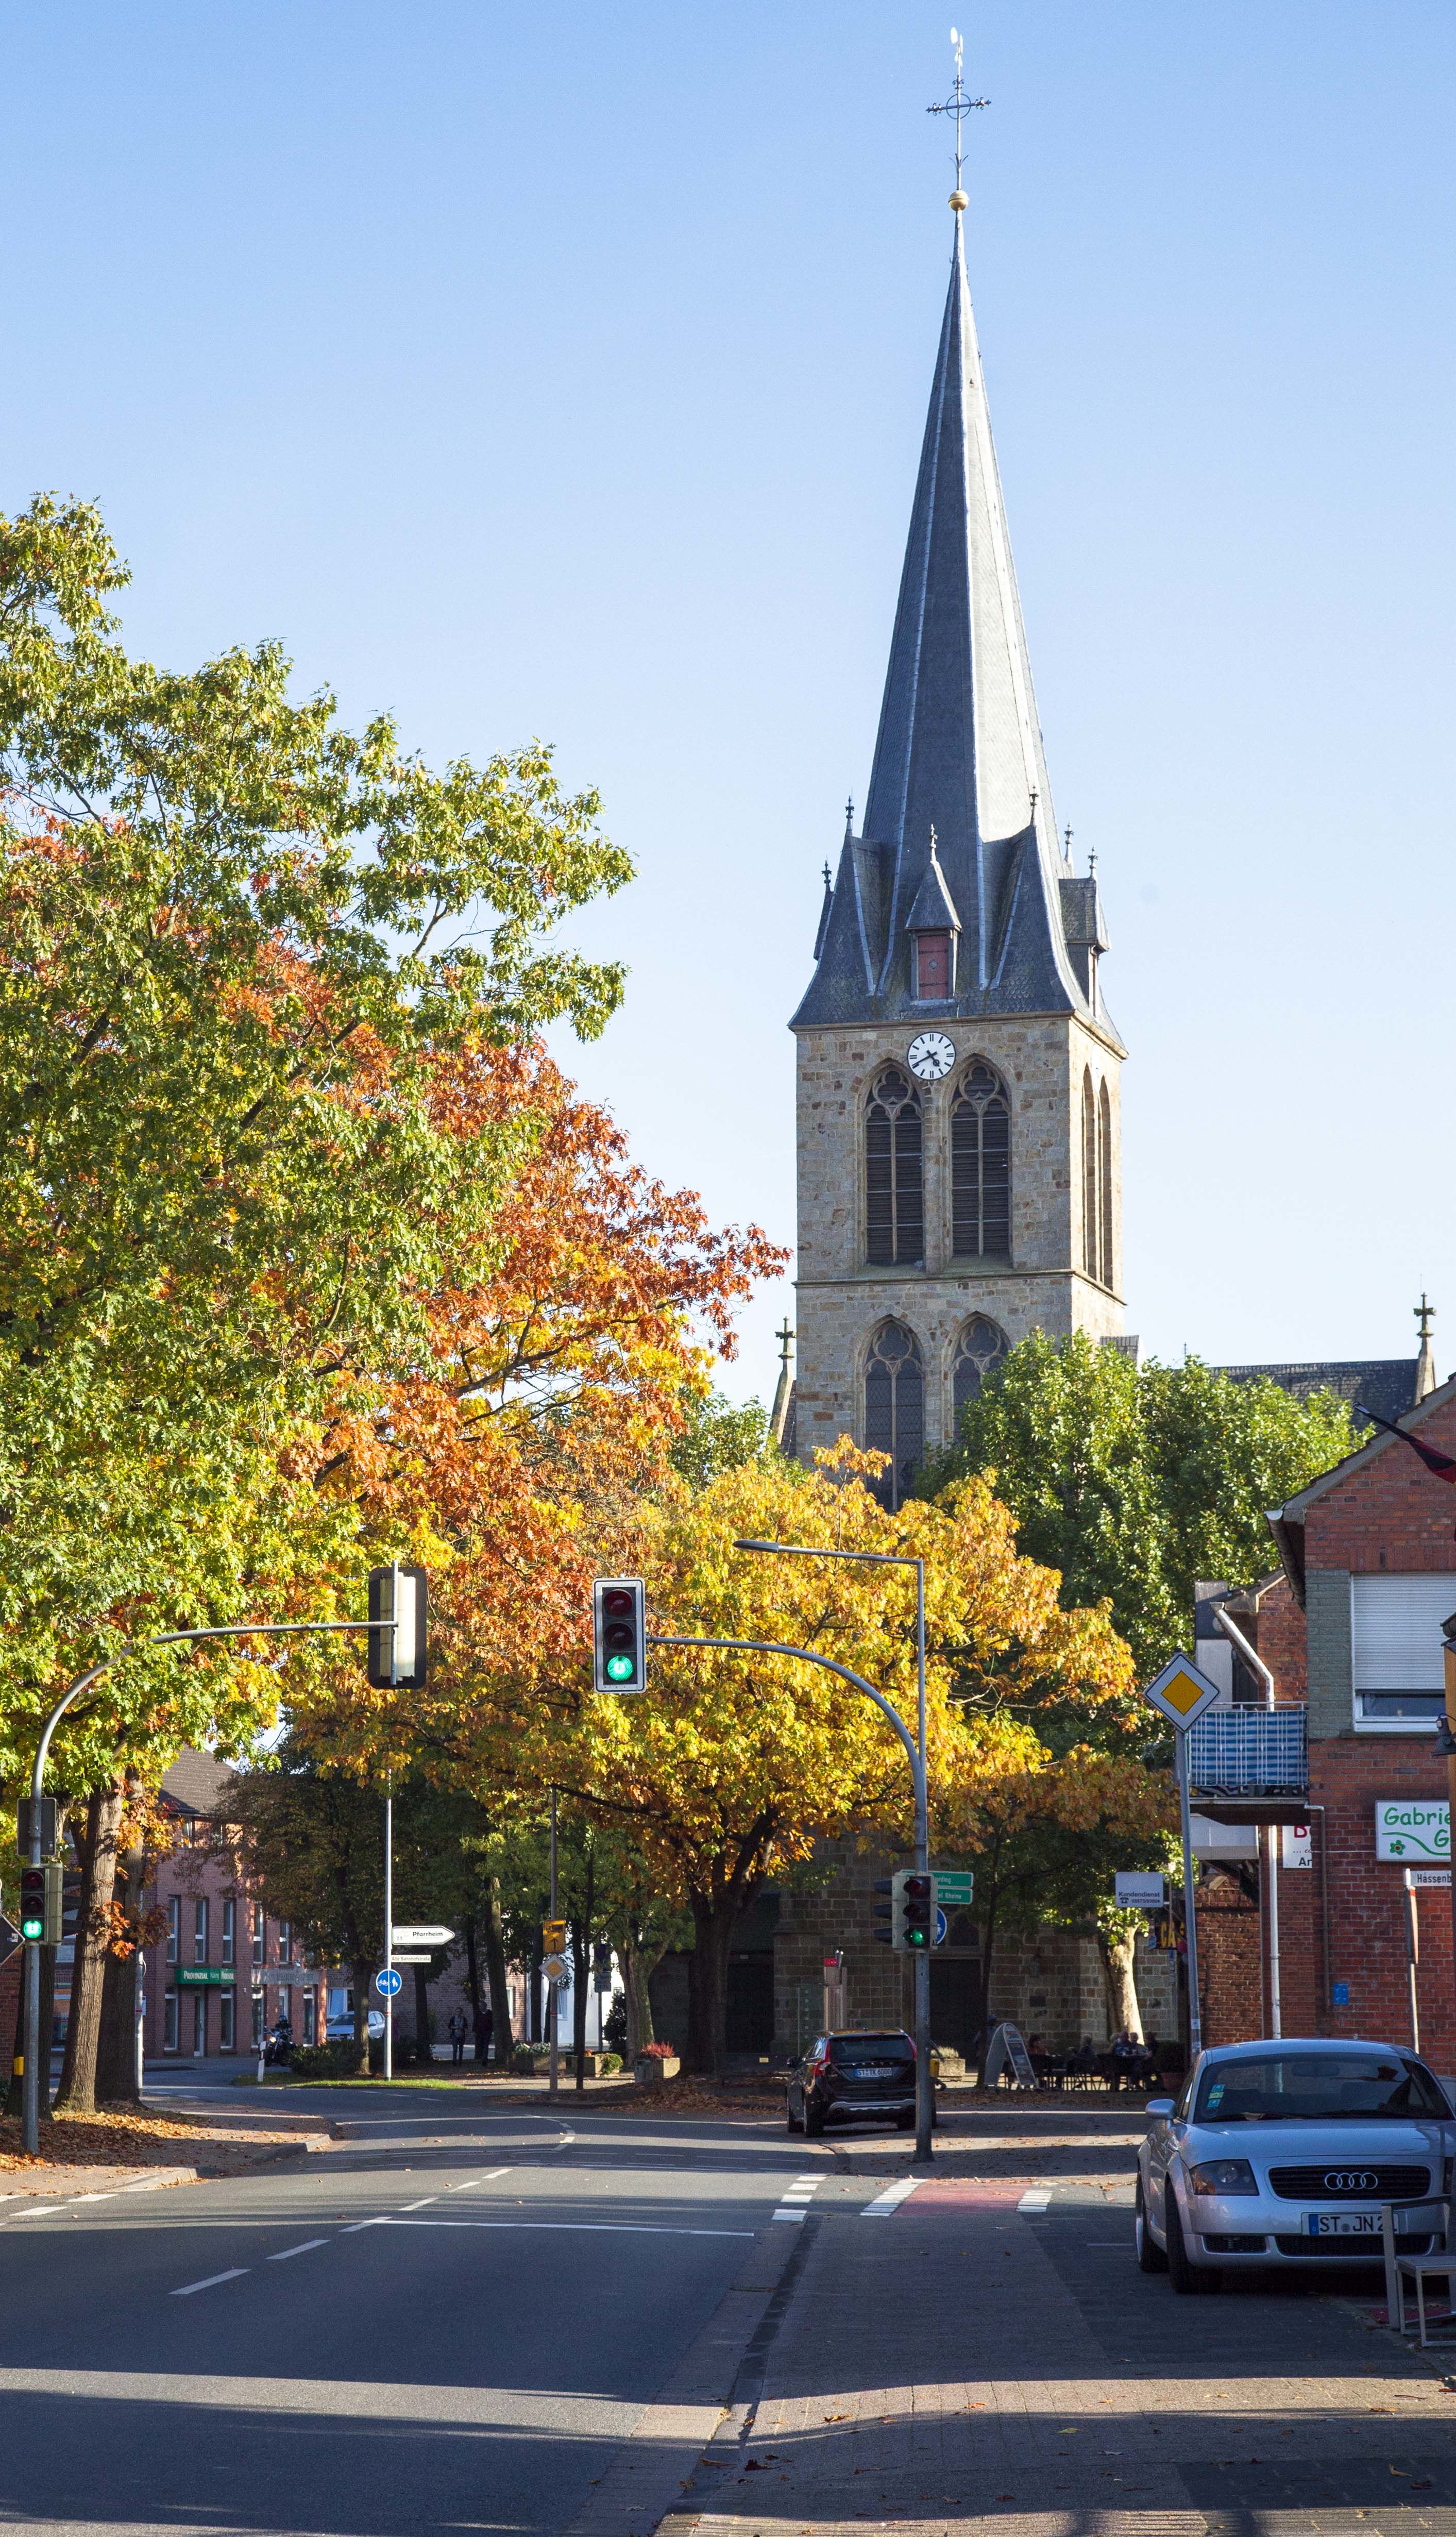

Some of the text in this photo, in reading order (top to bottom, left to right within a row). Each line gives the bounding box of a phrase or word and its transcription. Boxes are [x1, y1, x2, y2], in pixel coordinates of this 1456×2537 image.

[1384, 1807, 1450, 1825] Gabrie
[1434, 1829, 1450, 1847] G
[1417, 1874, 1452, 1883] Hassenb
[1319, 2216, 1341, 2232] ST
[1352, 2216, 1374, 2231] JN
